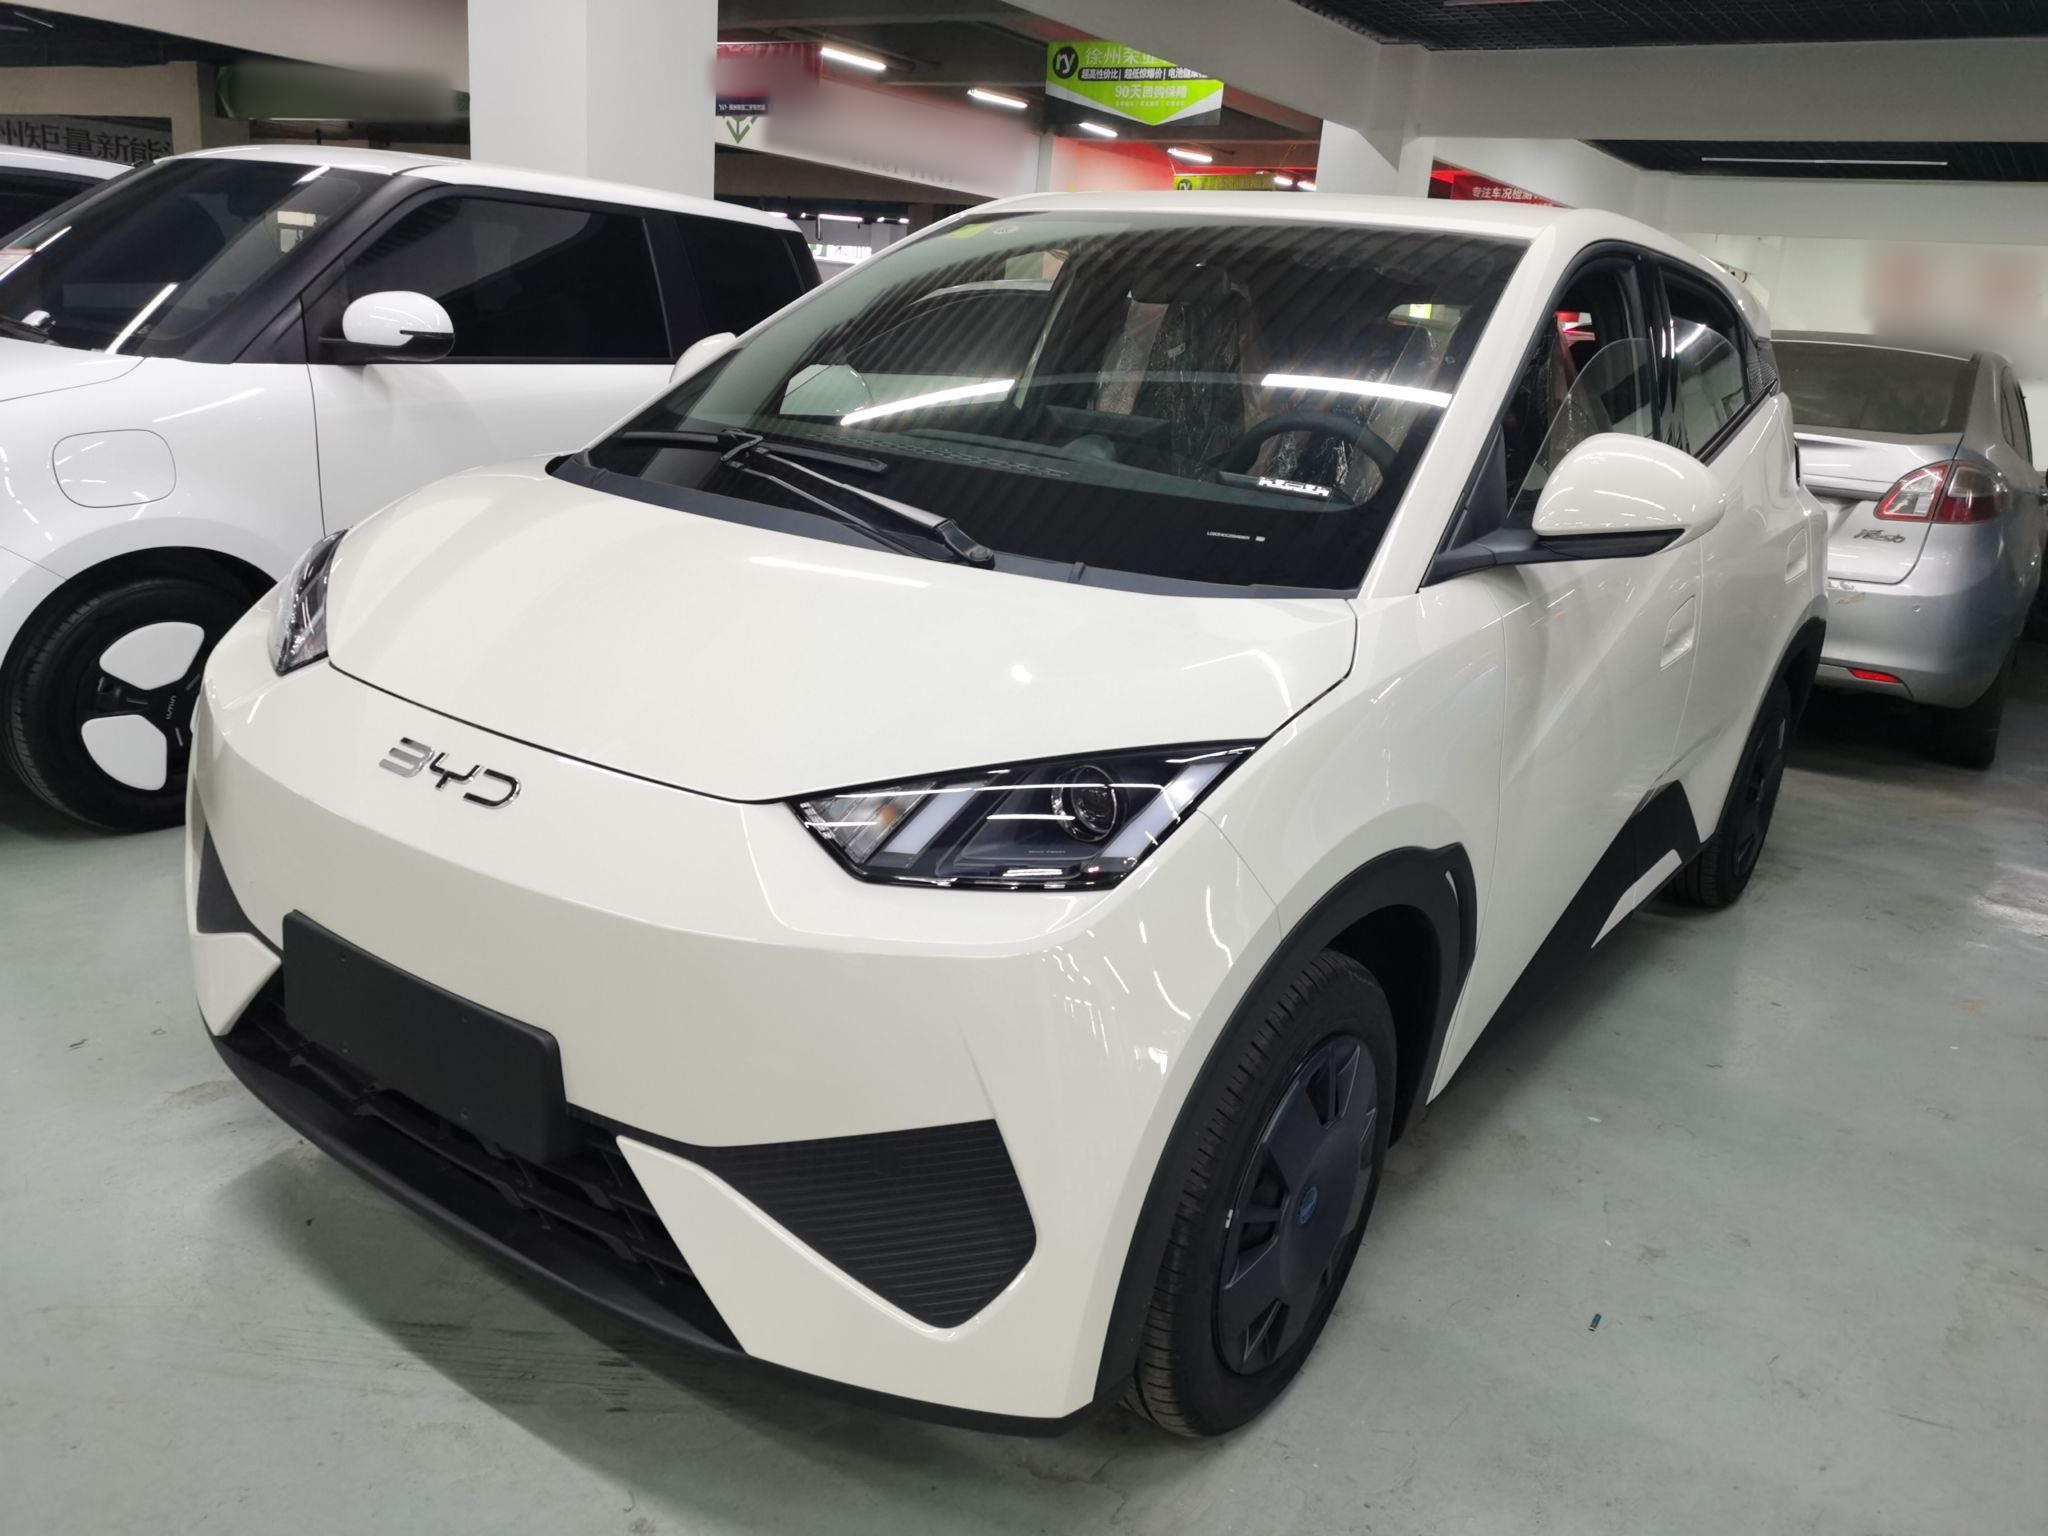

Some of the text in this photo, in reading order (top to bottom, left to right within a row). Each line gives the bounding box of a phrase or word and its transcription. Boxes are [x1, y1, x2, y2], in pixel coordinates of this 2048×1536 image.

[1472, 187, 1537, 200] 专注车况检测
[379, 737, 521, 809] BYD
